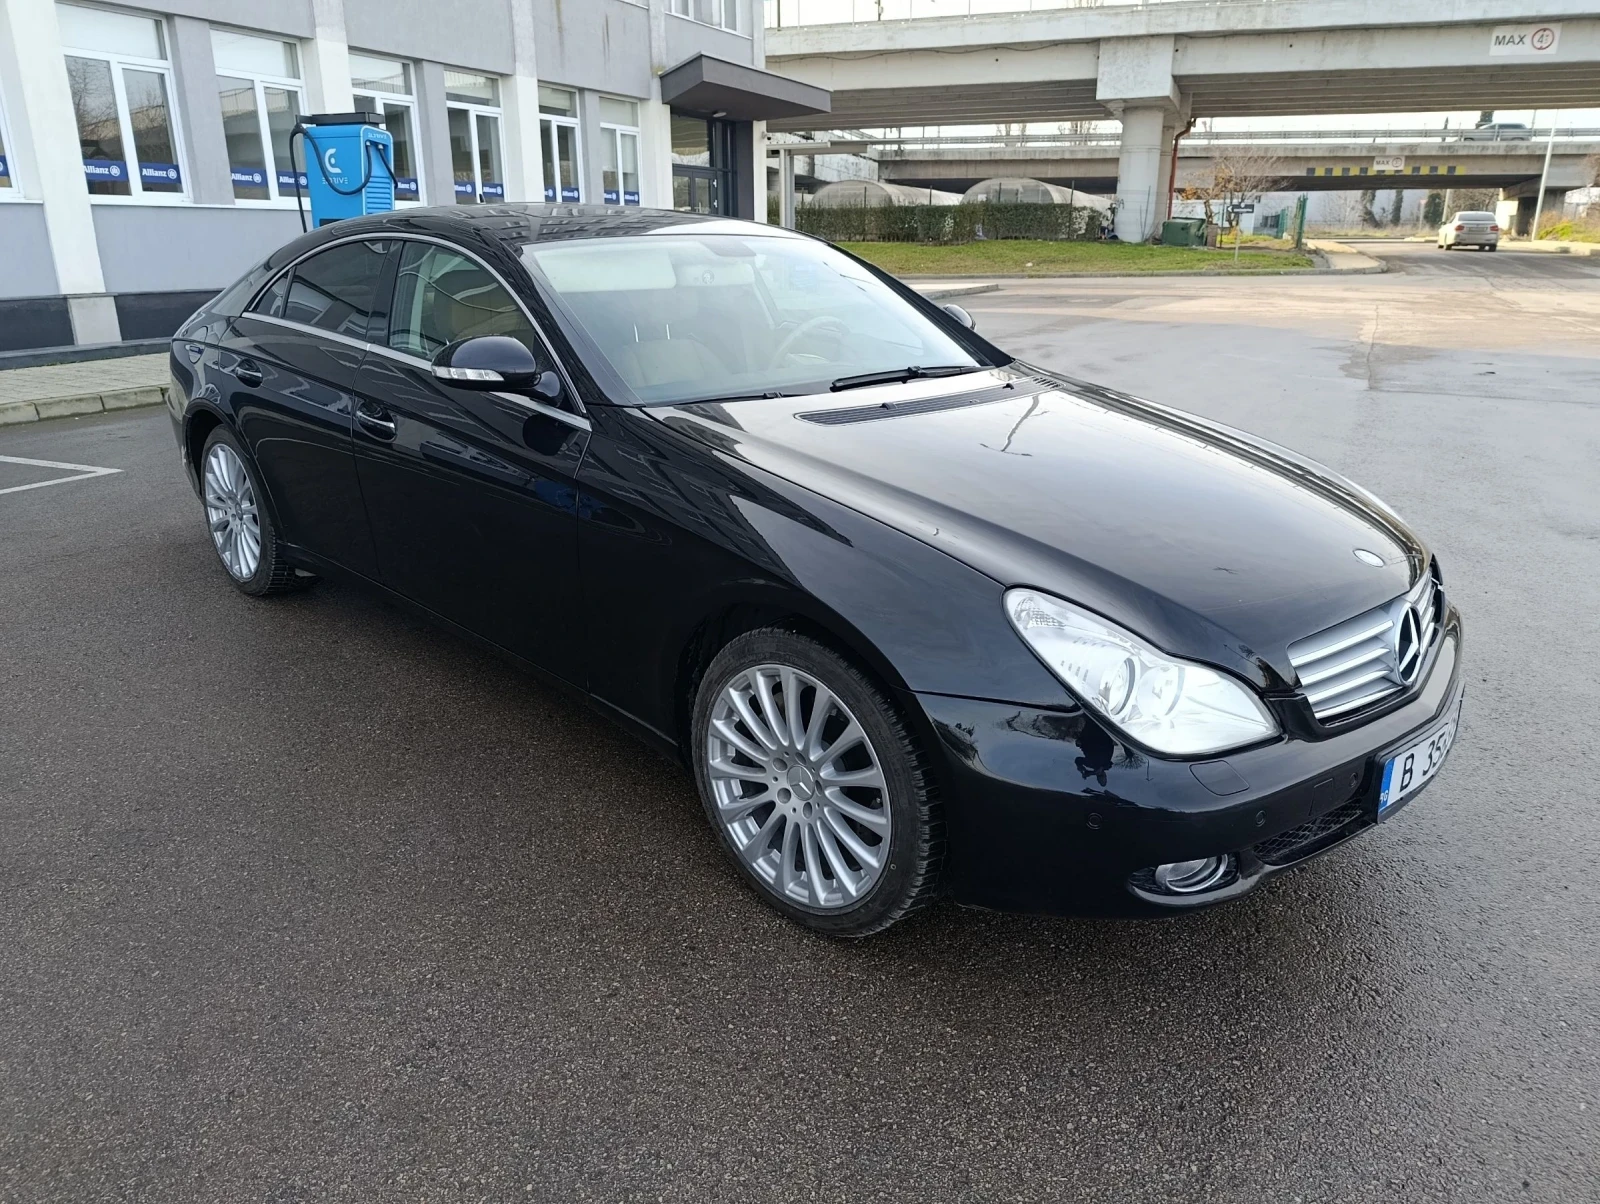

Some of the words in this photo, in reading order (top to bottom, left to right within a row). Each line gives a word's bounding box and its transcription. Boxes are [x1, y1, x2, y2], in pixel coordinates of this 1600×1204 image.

[1494, 34, 1527, 46] MAX
[83, 165, 109, 174] Allianz
[142, 168, 167, 177] Allianz
[231, 173, 253, 181] Allianz
[1399, 752, 1415, 793] B
